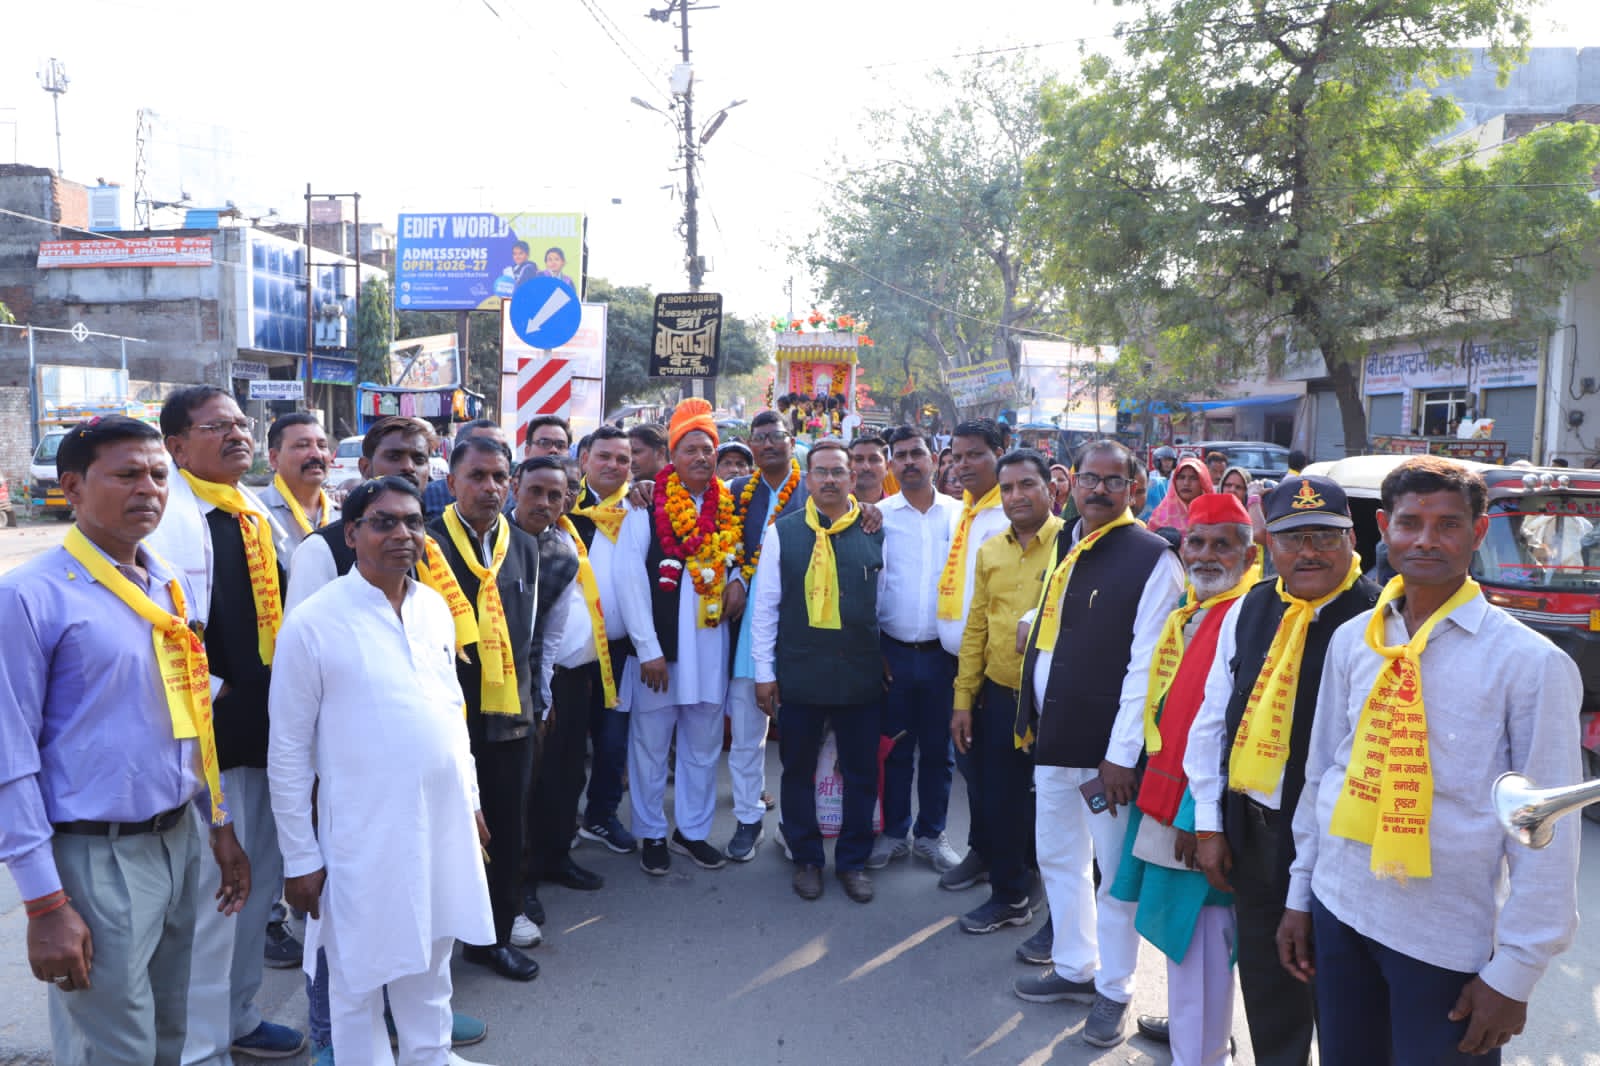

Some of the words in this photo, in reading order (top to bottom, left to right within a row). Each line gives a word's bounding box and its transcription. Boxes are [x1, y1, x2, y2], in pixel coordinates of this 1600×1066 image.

[403, 216, 448, 239] EDIFY
[452, 215, 509, 238] WORLD
[515, 215, 578, 238] SCHOOL
[402, 248, 488, 260] ADMISSIONS
[402, 260, 433, 271] OPEN
[436, 260, 487, 271] 2026-27
[655, 318, 718, 359] बालाजी
